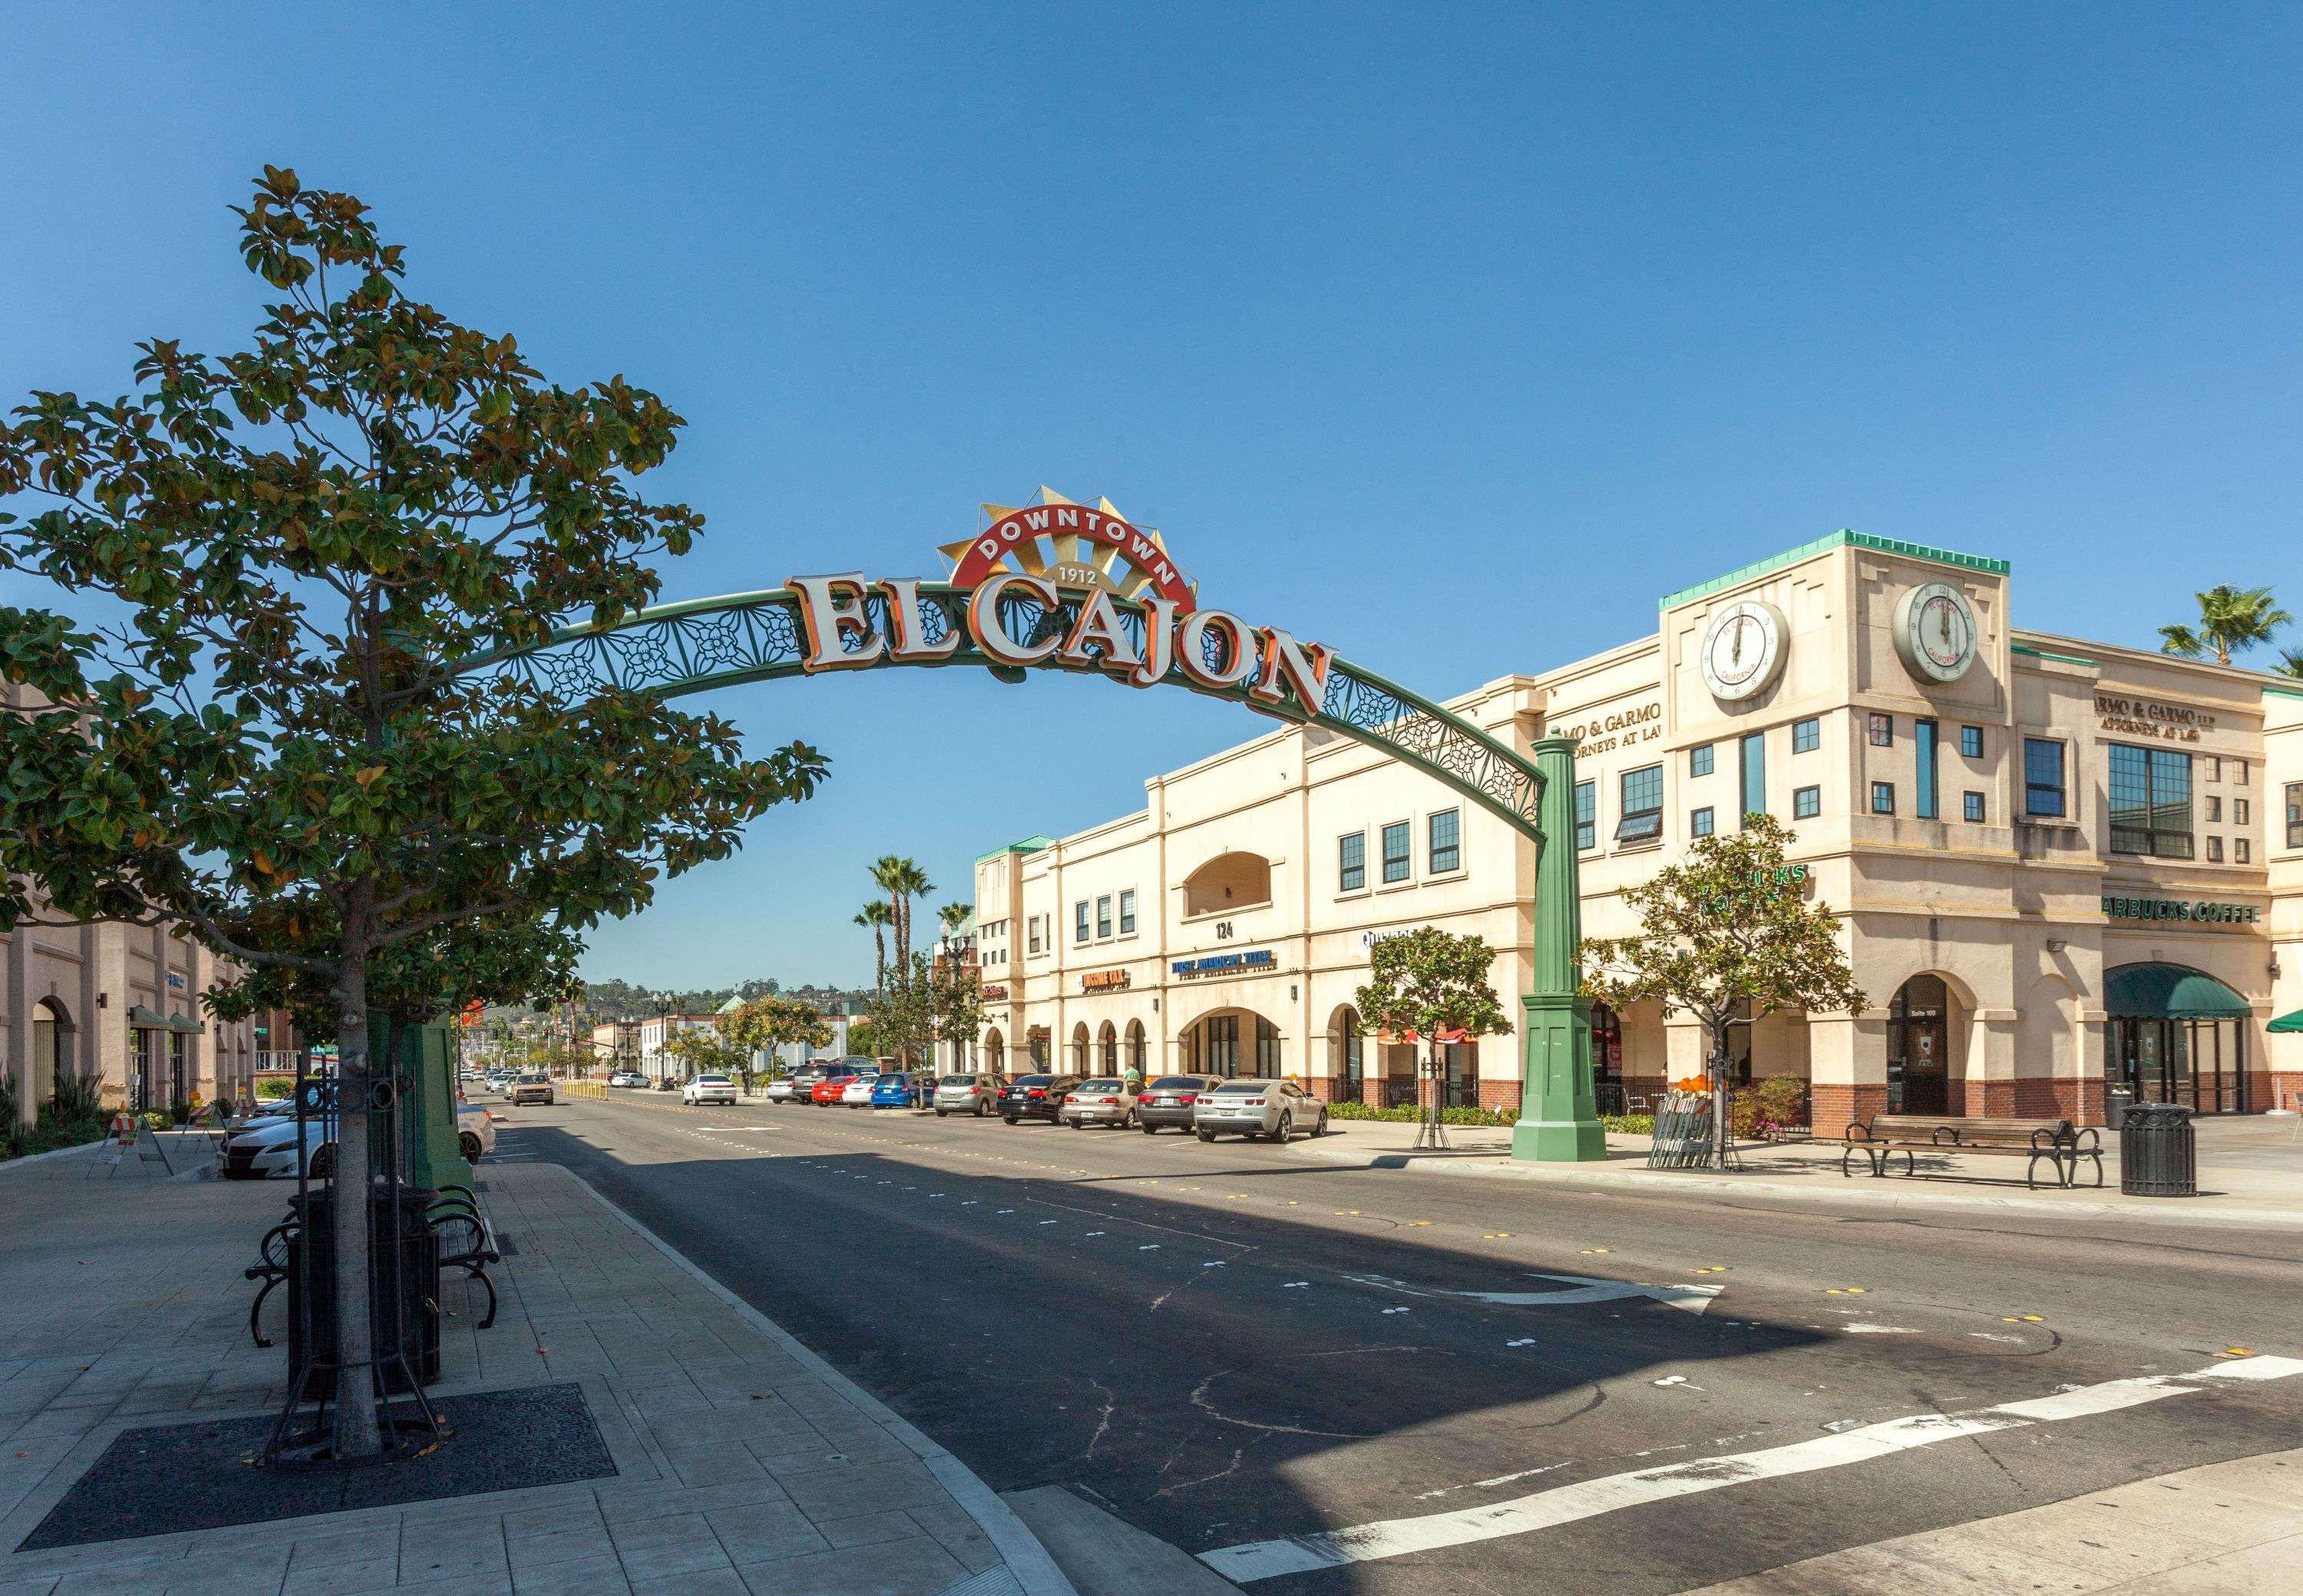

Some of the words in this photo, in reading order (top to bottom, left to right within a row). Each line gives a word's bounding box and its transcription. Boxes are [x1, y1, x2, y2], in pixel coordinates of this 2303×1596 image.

[979, 508, 1176, 585] DOWNTOWN
[1059, 566, 1097, 586] 1912
[785, 571, 960, 672] EL
[967, 573, 1340, 717] CAJON
[1928, 647, 1960, 664] CALIFORNIA
[1721, 664, 1756, 682] CALIFORNIA
[1562, 725, 1587, 742] MO
[1589, 720, 1604, 737] &
[1605, 702, 1660, 732] GARMO
[2133, 702, 2145, 718] &
[2148, 705, 2196, 725] GARMO
[1622, 732, 1637, 746] AT
[2196, 901, 2261, 923] COFFEE
[1216, 922, 1233, 940] 124
